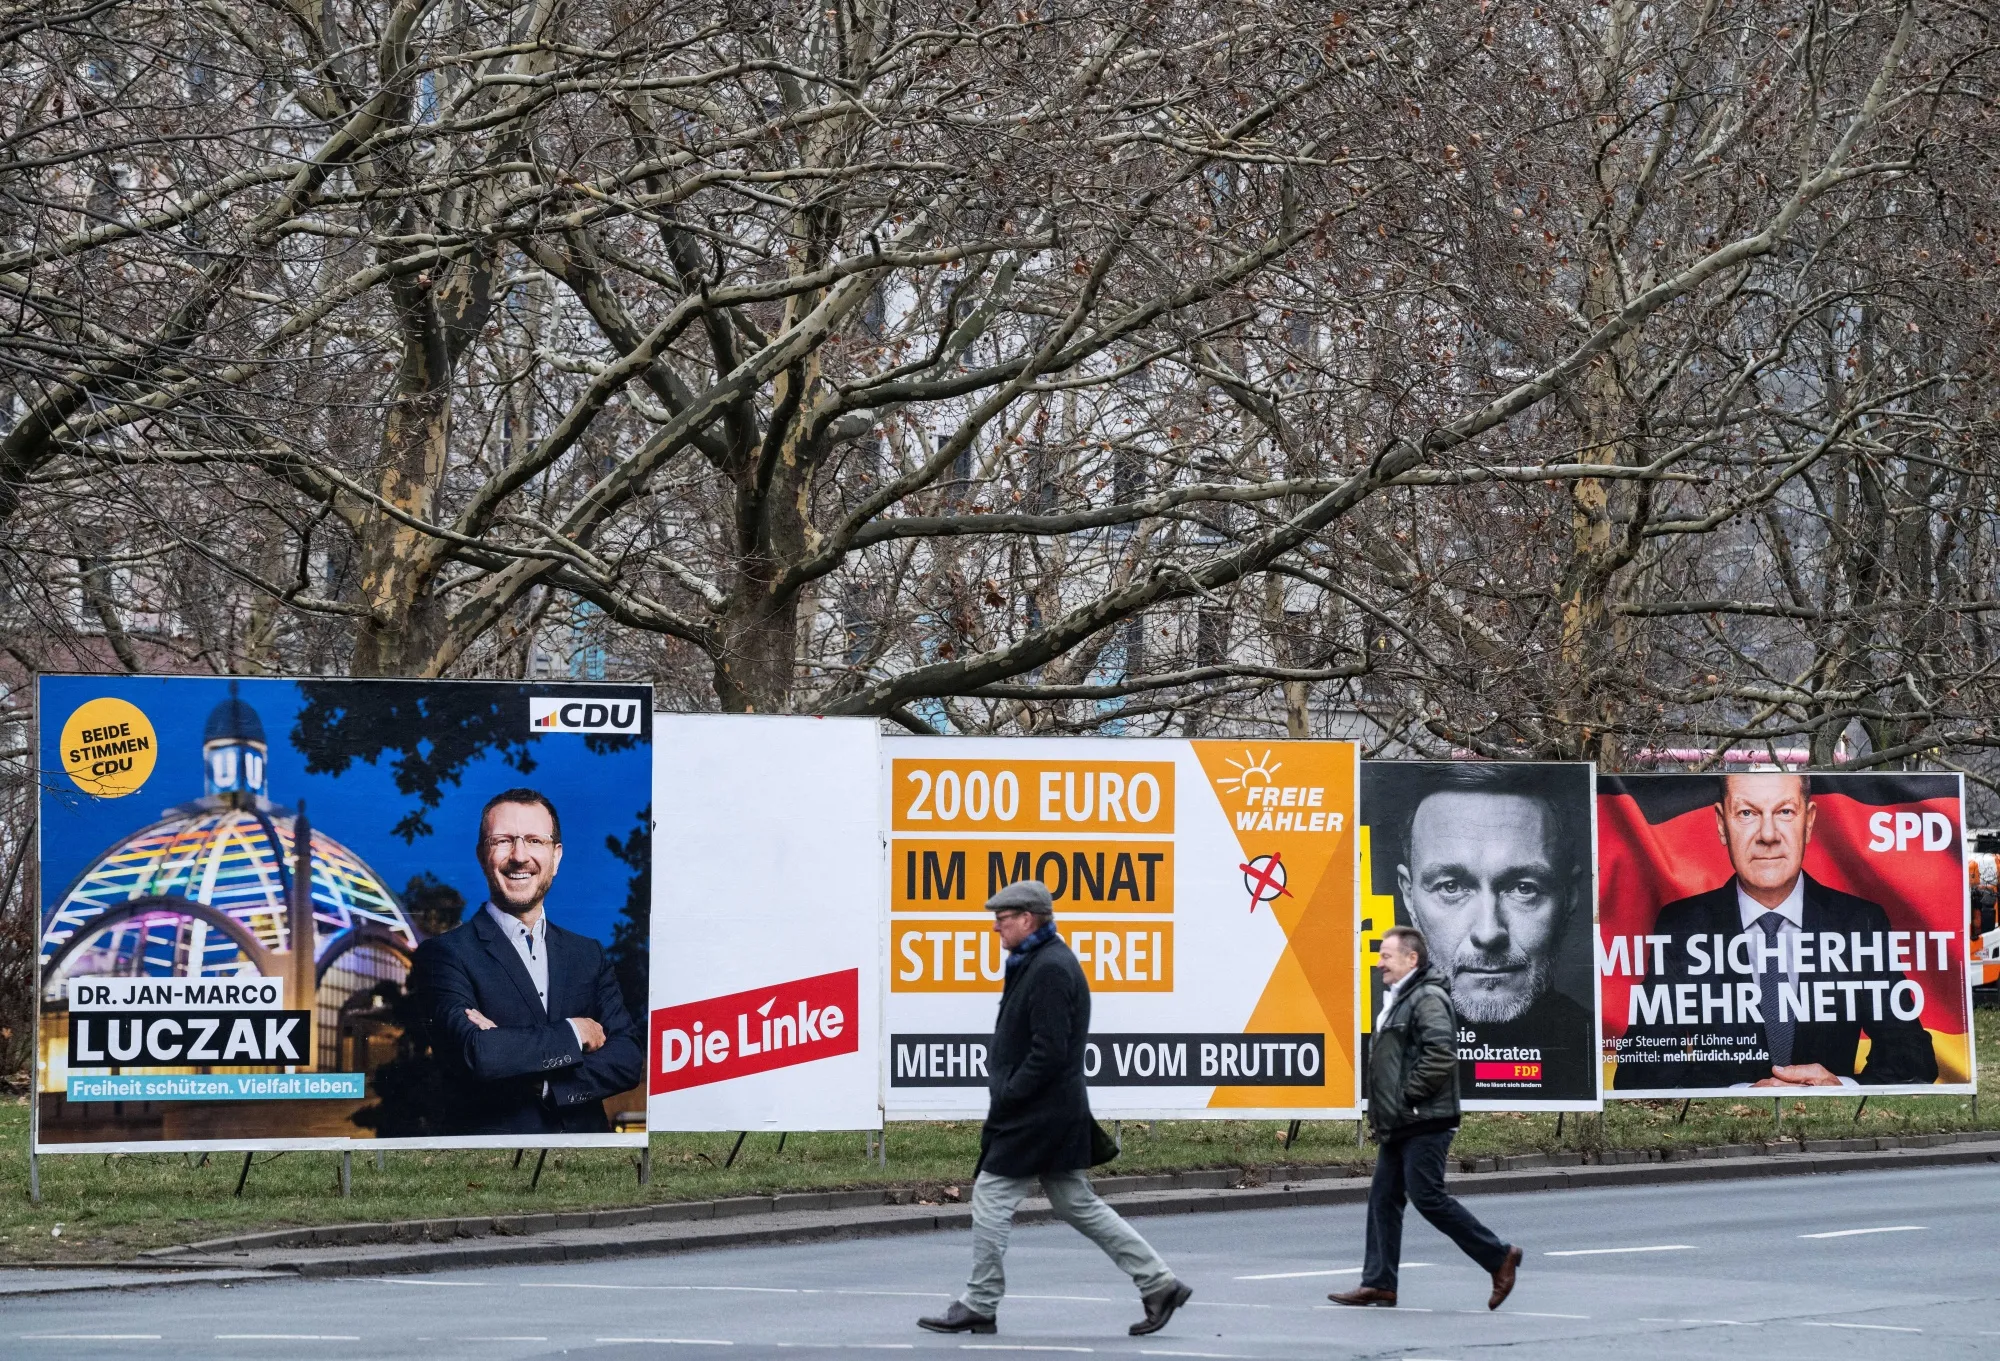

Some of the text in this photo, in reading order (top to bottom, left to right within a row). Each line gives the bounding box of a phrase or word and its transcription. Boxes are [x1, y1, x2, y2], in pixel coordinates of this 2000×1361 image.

[560, 703, 636, 729] CDU
[82, 723, 131, 744] BEIDE
[69, 736, 150, 763] STIMMEN
[92, 757, 133, 776] CDU
[906, 770, 1161, 823] 2000 EURO
[1246, 787, 1325, 807] FREIE
[1236, 807, 1344, 832] WÄHLER
[1868, 811, 1953, 853] SPD
[907, 851, 1164, 902] IM MONAT
[900, 931, 1162, 982] STEUFREI
[1598, 931, 1955, 977] MIT SICHERHEIT
[77, 985, 277, 1005] DR. JAN-MARCO
[1628, 979, 1925, 1025] MEHR NETTO
[76, 1018, 300, 1062] LUCZAK
[661, 996, 844, 1074] Die Linke
[1635, 1035, 1677, 1047] Steuern
[1680, 1034, 1698, 1046] auf
[1701, 1033, 1733, 1046] Löhne
[1736, 1033, 1757, 1045] und
[897, 1042, 989, 1078] MEHR
[1112, 1042, 1187, 1077] VOM
[1200, 1042, 1320, 1077] BRUTTO
[1663, 1048, 1769, 1064] mehrfürdich.spd.de
[1514, 1066, 1539, 1077] FDP
[73, 1078, 358, 1096] Freiheit schützen. Vielfalt leben.
